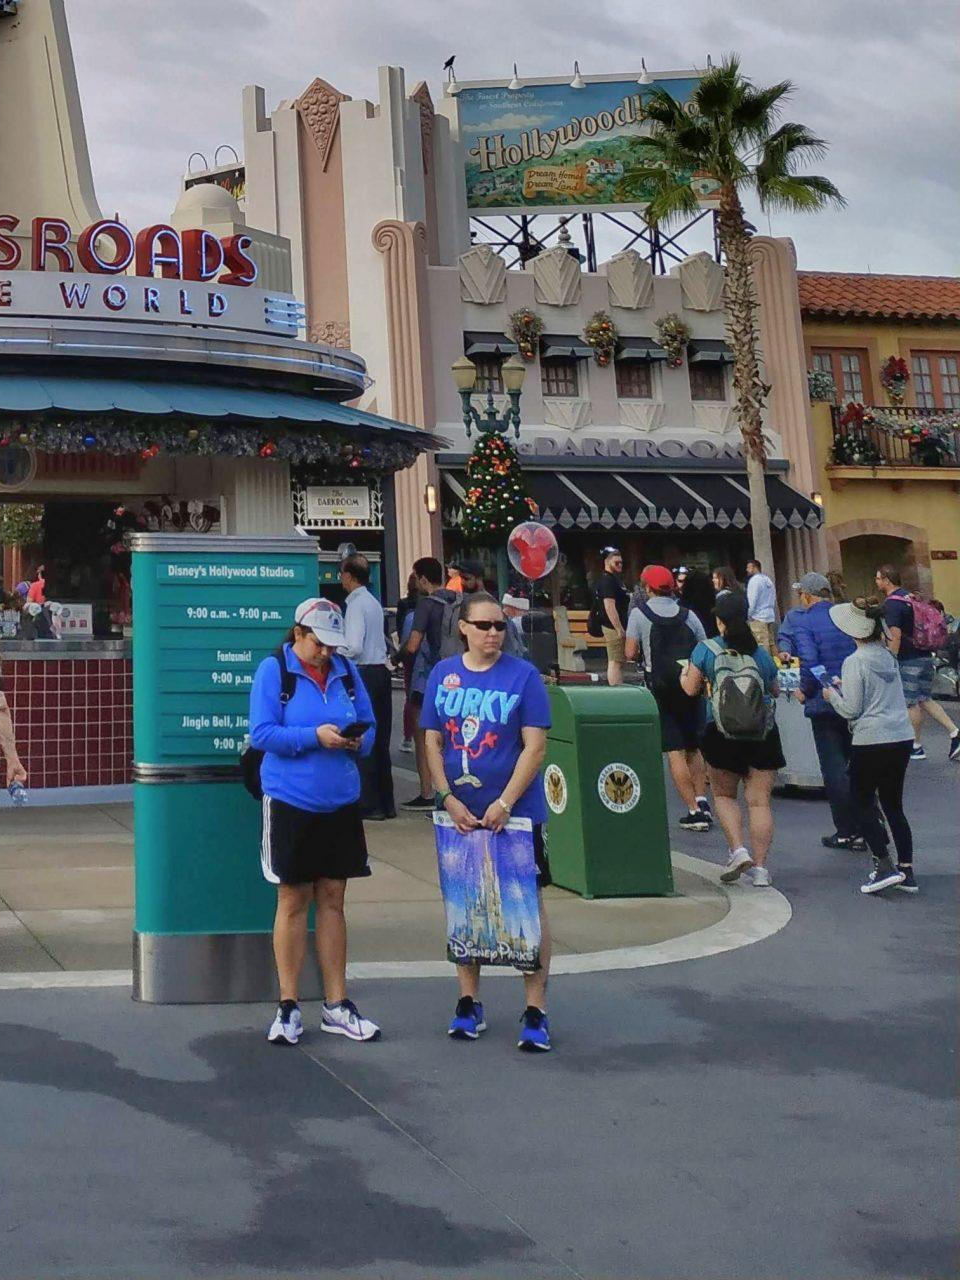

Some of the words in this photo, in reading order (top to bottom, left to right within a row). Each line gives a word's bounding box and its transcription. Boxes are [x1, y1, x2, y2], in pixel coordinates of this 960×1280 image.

[527, 170, 556, 179] Dream
[526, 180, 554, 189] Dream
[555, 180, 579, 191] Land
[59, 281, 229, 317] WORLD
[534, 437, 744, 459] DARKROOM
[317, 498, 360, 507] DARKROOM
[168, 565, 207, 579] Disney's
[209, 565, 258, 579] Hollywood
[259, 566, 295, 578] Studios
[187, 607, 208, 619] 9:00
[210, 610, 230, 619] a.m.
[239, 607, 260, 619] 9:00
[262, 611, 282, 622] p.m.
[211, 672, 233, 684] 9:00
[235, 674, 255, 686] p.m.
[434, 684, 520, 725] FORKY
[182, 715, 210, 730] Jingle
[212, 715, 233, 729] Bell,
[235, 715, 250, 728] Jin
[213, 738, 234, 749] 9:00
